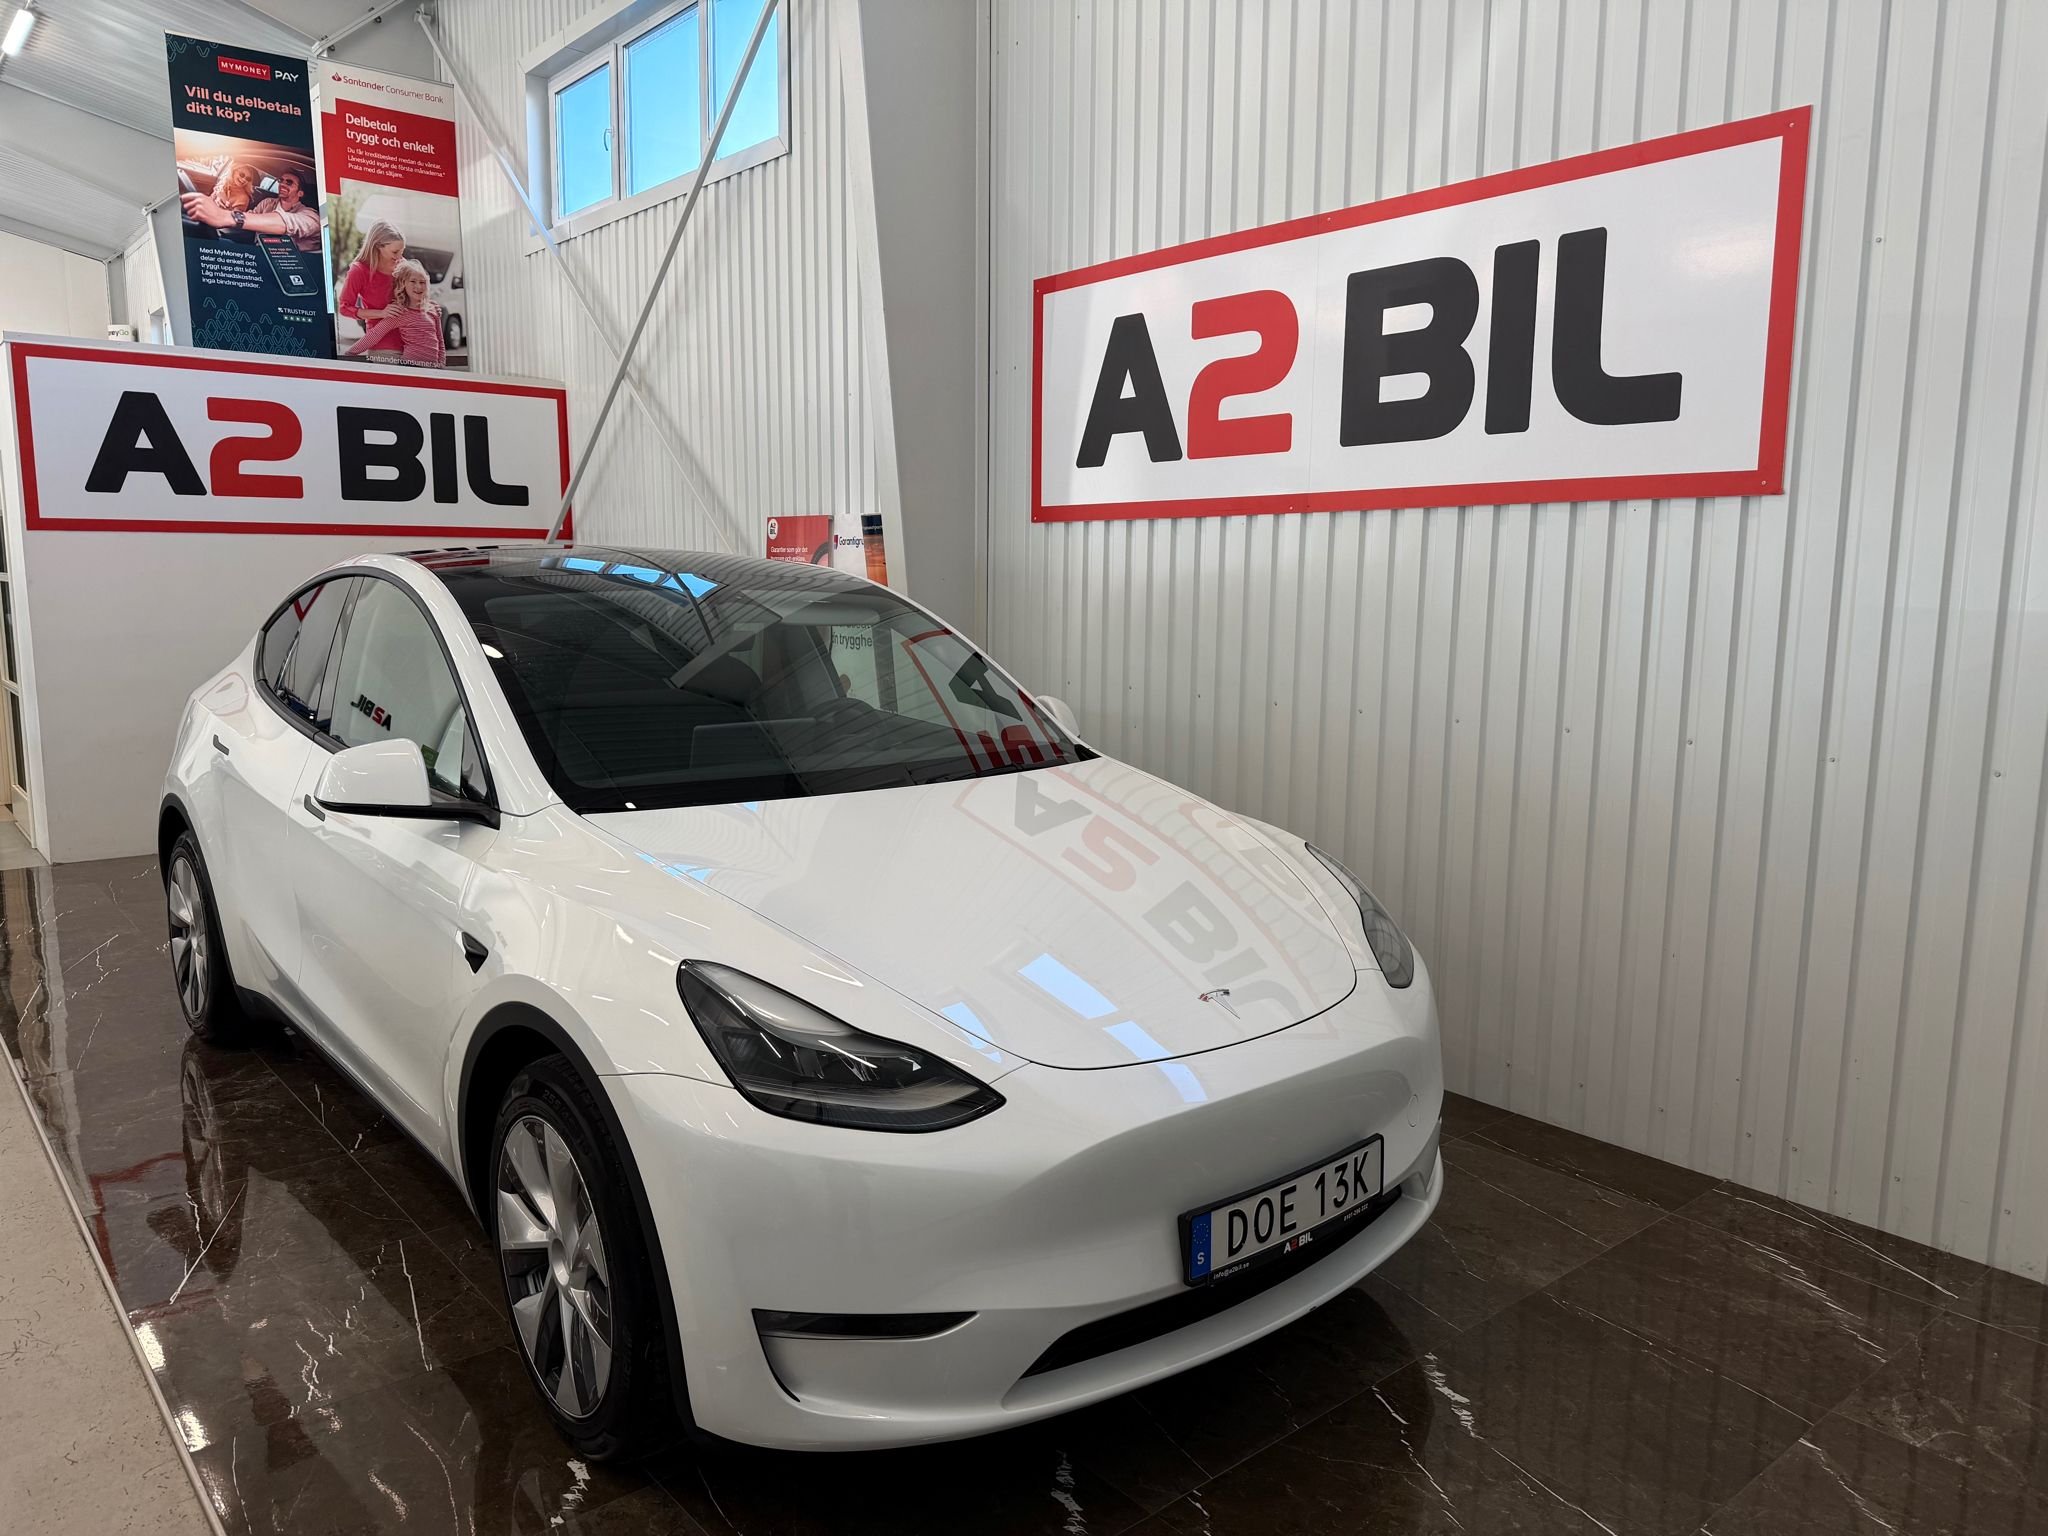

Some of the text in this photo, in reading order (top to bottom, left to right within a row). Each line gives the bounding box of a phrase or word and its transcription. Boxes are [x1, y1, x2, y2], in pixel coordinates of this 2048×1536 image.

[221, 62, 299, 82] MYMONEY PAY
[185, 85, 301, 116] Vill du delbetala
[343, 76, 443, 103] Santander Consumer Bank
[186, 102, 250, 122] ditt köp?
[346, 113, 397, 133] Delbetala
[346, 129, 435, 154] tryggt och enkelt
[214, 249, 243, 258] MyMoney
[1076, 227, 1682, 468] A2 BIL
[85, 390, 529, 506] A2 BIL
[1228, 1151, 1368, 1257] DOE 13K
[1299, 1232, 1313, 1246] BIL
[1198, 1252, 1204, 1264] S
